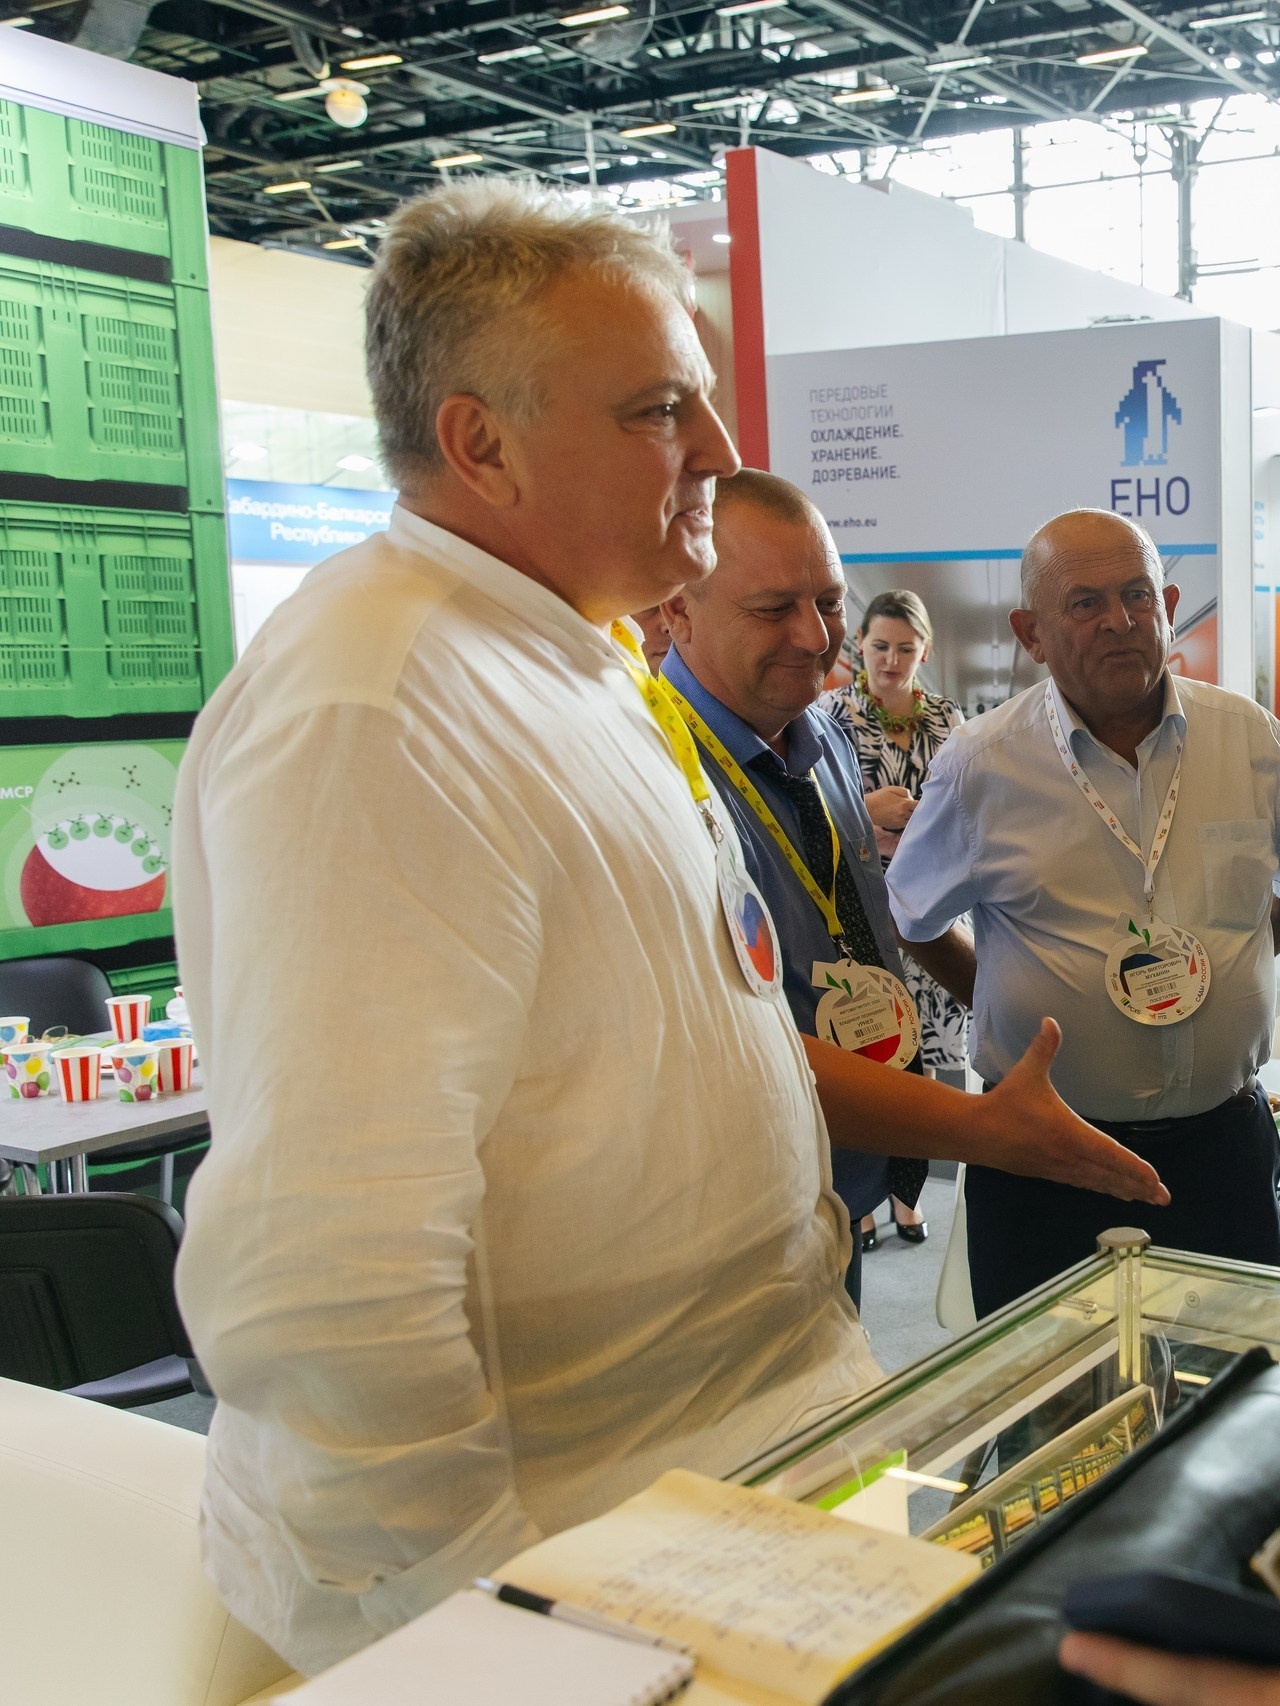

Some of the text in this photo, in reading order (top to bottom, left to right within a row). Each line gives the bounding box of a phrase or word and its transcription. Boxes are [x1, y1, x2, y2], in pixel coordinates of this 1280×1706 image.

[809, 383, 888, 403] ПЕРЕДОВЫЕ
[810, 404, 894, 423] ТЕХНОЛОГИИ
[810, 424, 904, 443] ОХЛАЖДЕНИЕ.
[811, 446, 882, 463] ХРАНЕНИЕ.
[812, 465, 901, 485] ДОЗРЕВАНИЕ.
[228, 496, 391, 526] абардино-Балкарс
[827, 517, 878, 528] ww.eho.eu
[269, 522, 367, 547] Республика
[903, 999, 915, 1025] РОССИИ
